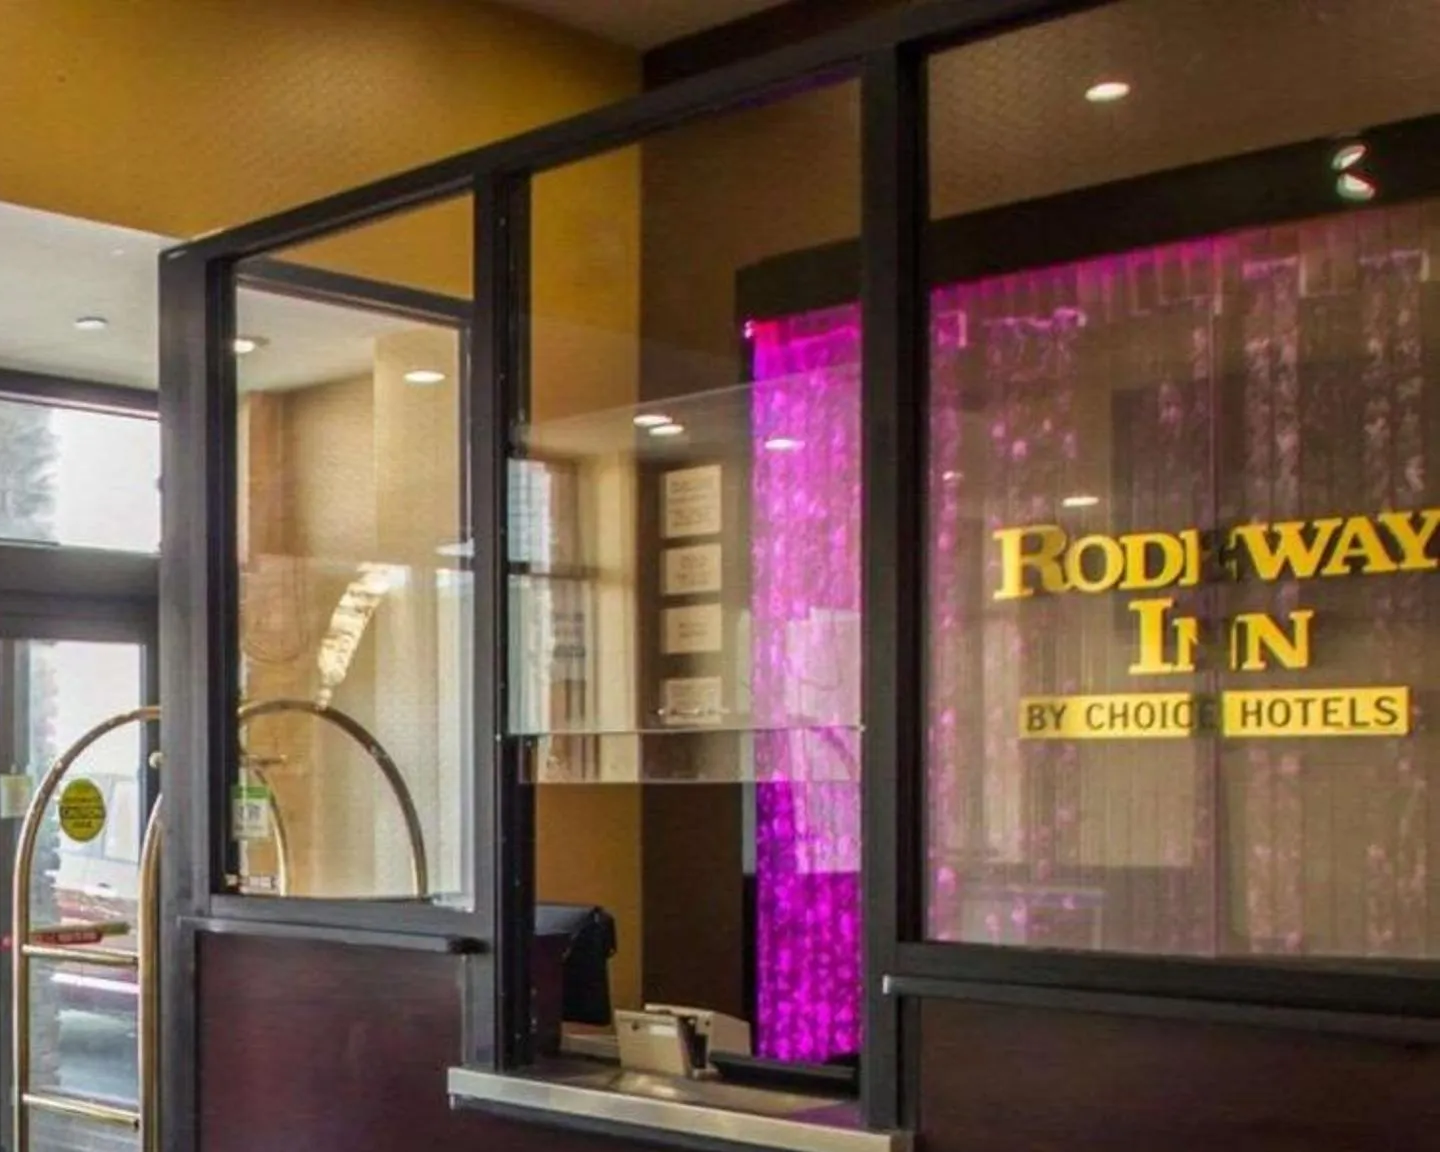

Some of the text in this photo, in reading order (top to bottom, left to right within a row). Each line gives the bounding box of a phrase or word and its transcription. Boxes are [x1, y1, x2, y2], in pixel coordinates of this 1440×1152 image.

[1026, 695, 1399, 732] BY CHOICE HOTELS
